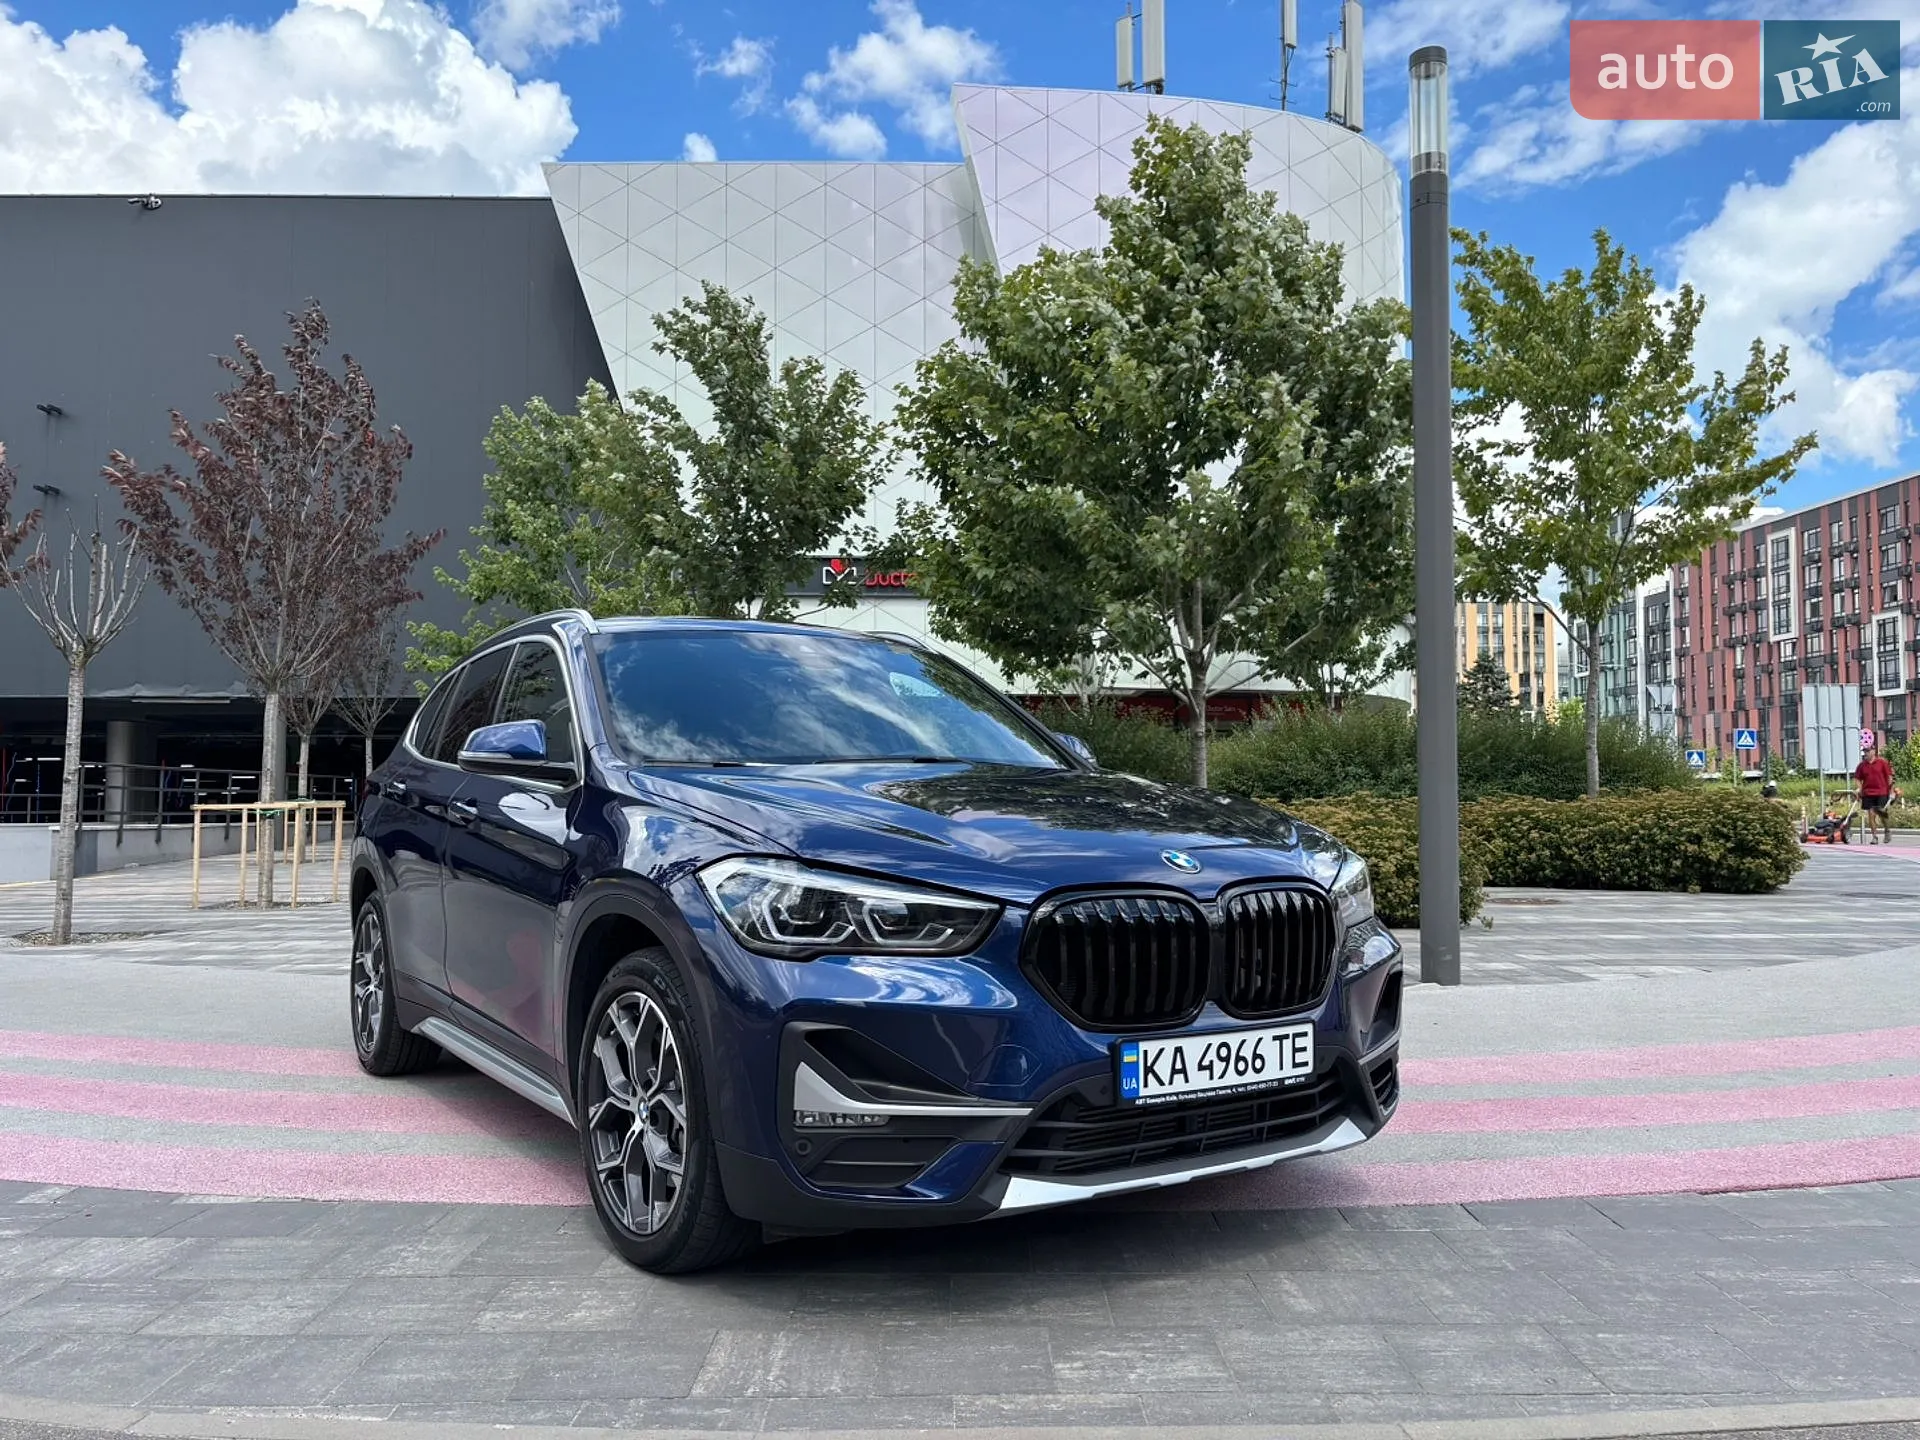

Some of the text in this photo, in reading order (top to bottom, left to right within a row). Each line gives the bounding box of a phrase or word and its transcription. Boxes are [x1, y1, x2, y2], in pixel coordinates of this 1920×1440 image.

[1142, 1031, 1309, 1088] KA 4966 TE
[1123, 1077, 1138, 1091] UA
